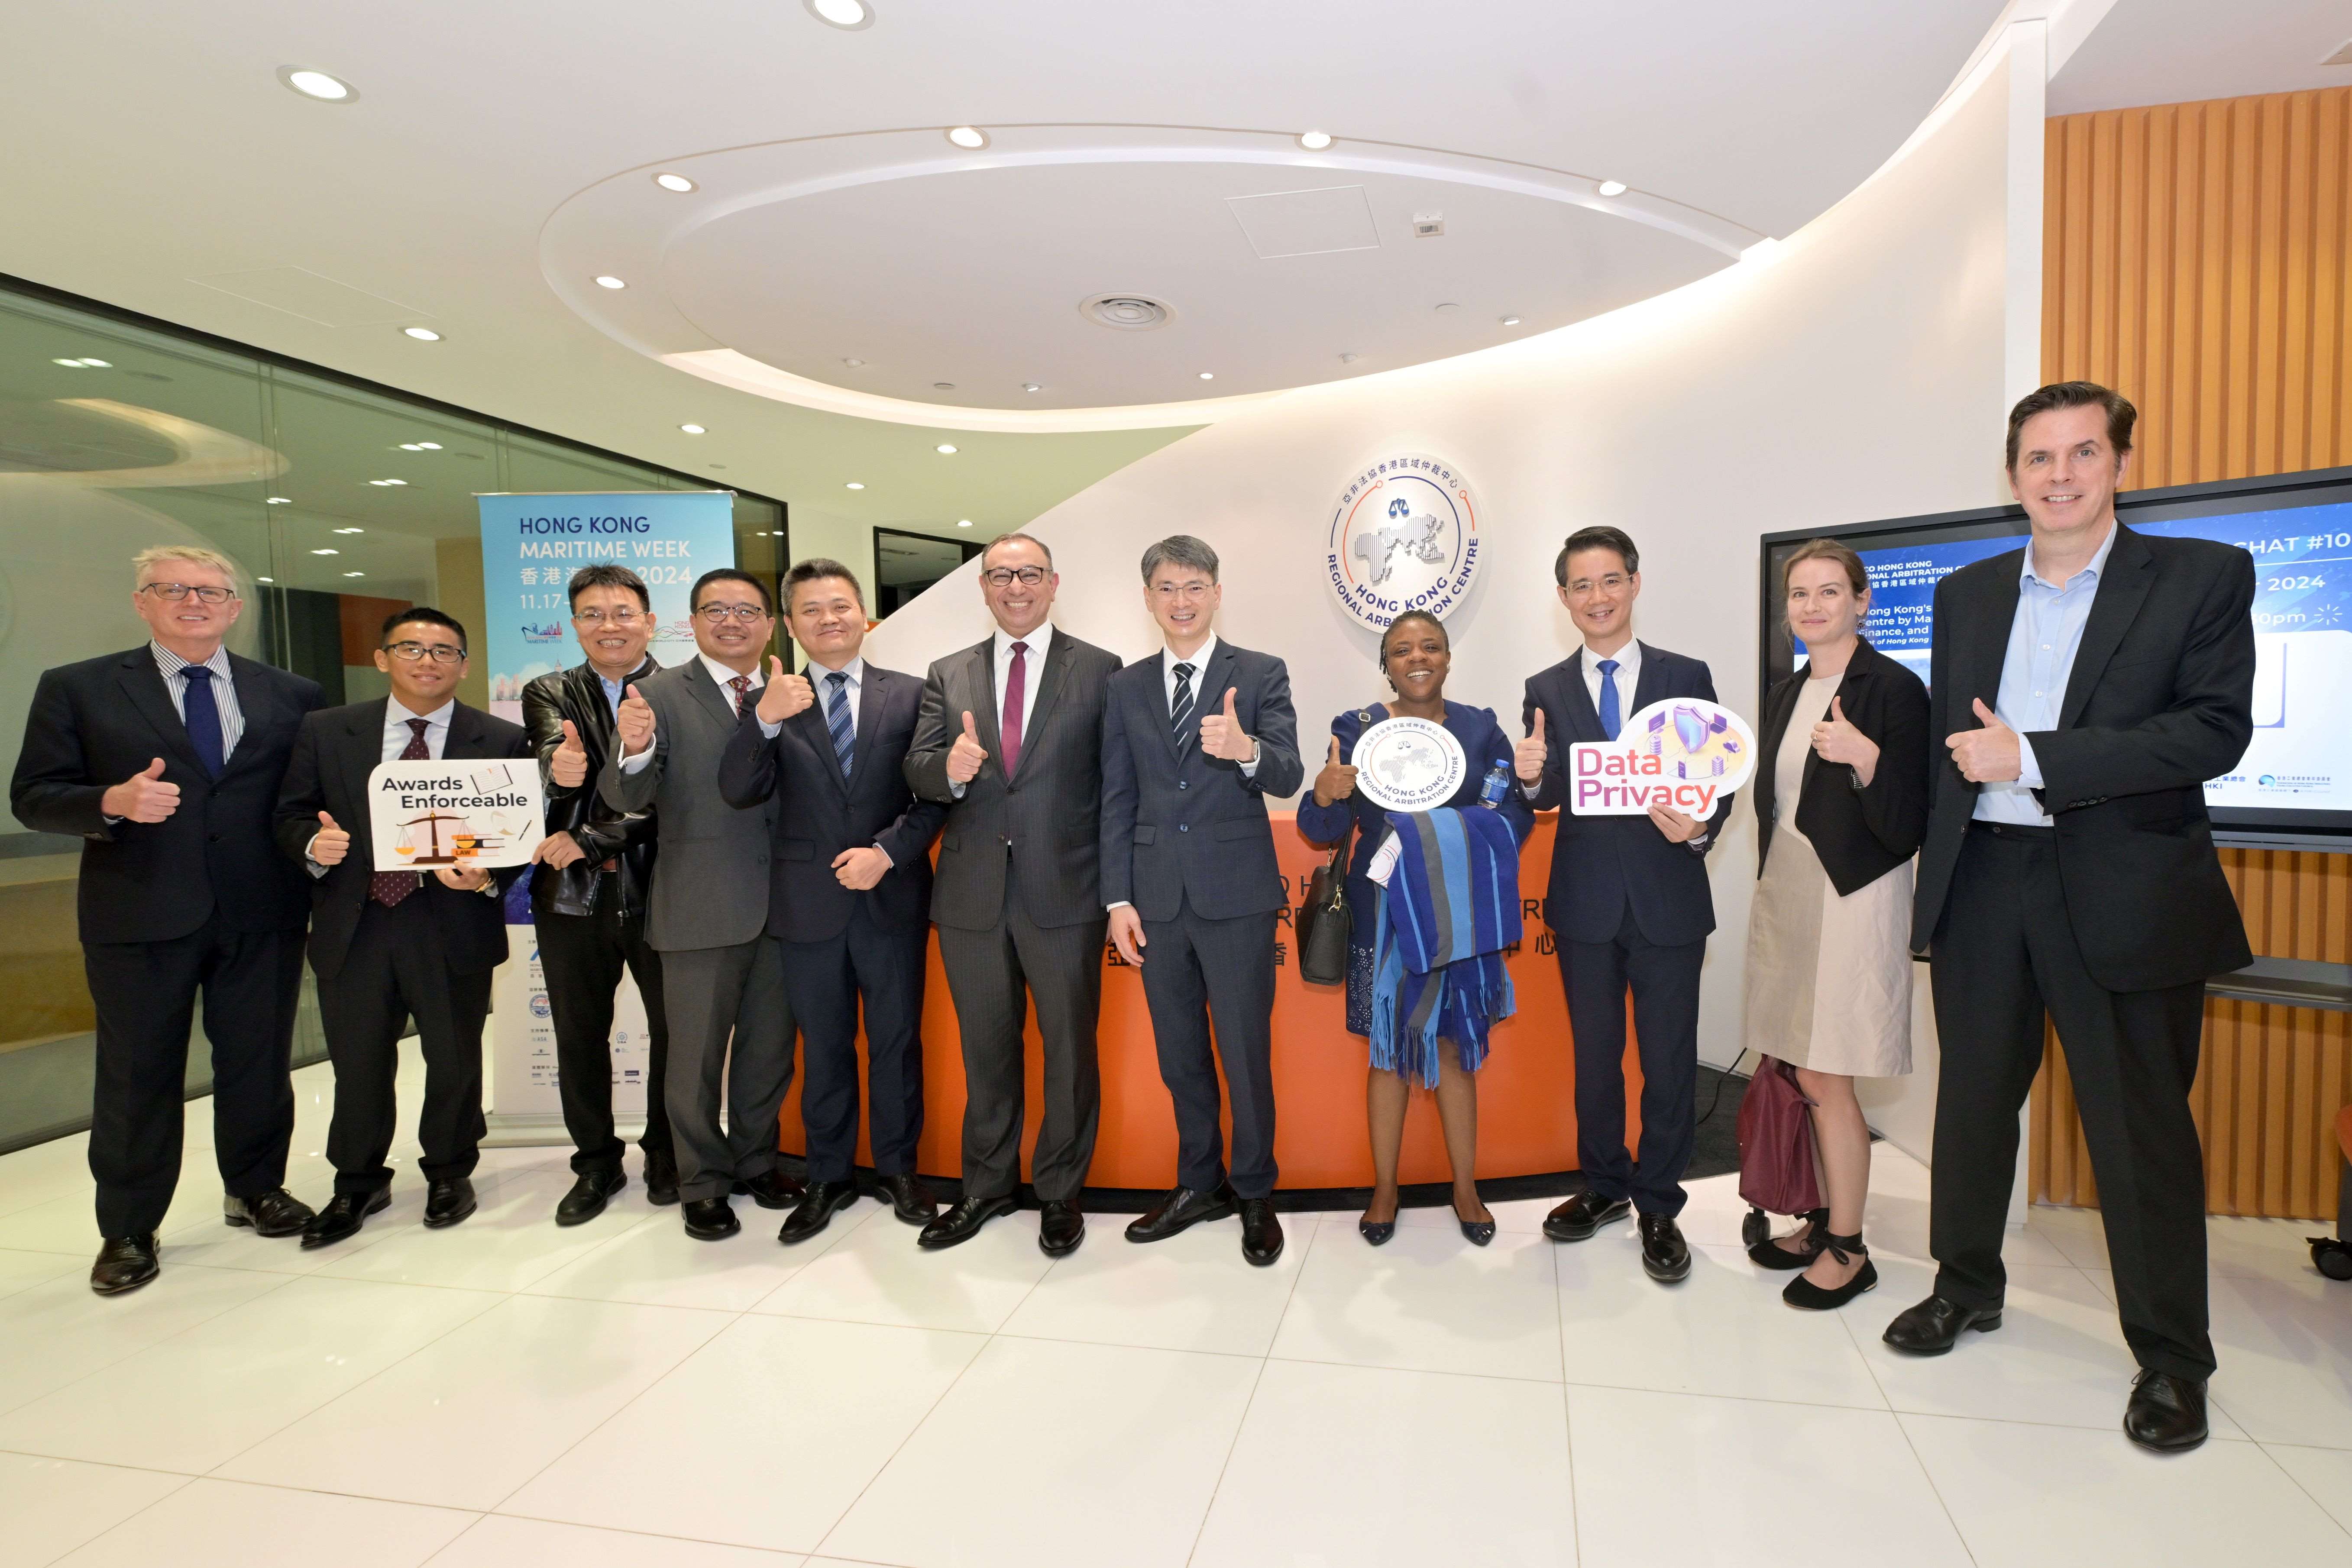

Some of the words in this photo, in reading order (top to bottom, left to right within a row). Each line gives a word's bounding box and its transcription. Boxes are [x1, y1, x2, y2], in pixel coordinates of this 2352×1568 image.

[1343, 458, 1458, 504] 亞非法協香港區域仲裁中心
[520, 517, 582, 534] HONG
[590, 517, 650, 533] KONG
[520, 541, 627, 559] MARITIME
[632, 540, 691, 557] WEEK
[2307, 533, 2351, 550] #10
[1877, 563, 1903, 572] HONG
[1906, 560, 1932, 569] KONG
[1891, 566, 1953, 578] ARBITRATION
[637, 566, 692, 585] 2024
[1328, 554, 1362, 617] REGIONAL
[1452, 538, 1478, 595] CENTRE
[2268, 575, 2326, 591] 2024
[1355, 584, 1398, 612] HONG
[1405, 576, 1448, 611] KONG
[1867, 608, 1891, 617] ong
[1894, 604, 1932, 614] Kong's
[1863, 618, 1895, 626] entre
[1898, 616, 1912, 626] by
[1915, 615, 1933, 624] Ma
[1907, 625, 1928, 635] and
[1577, 748, 1662, 776] Data
[382, 776, 463, 791] Awards
[1361, 771, 1392, 802] REGIONAL
[1394, 784, 1449, 805] ARBITRATION
[1447, 756, 1459, 784] CENTRE
[1384, 784, 1415, 796] HONG
[1419, 775, 1444, 795] KONG
[401, 793, 528, 809] Enforceable
[1578, 779, 1717, 814] Privacy
